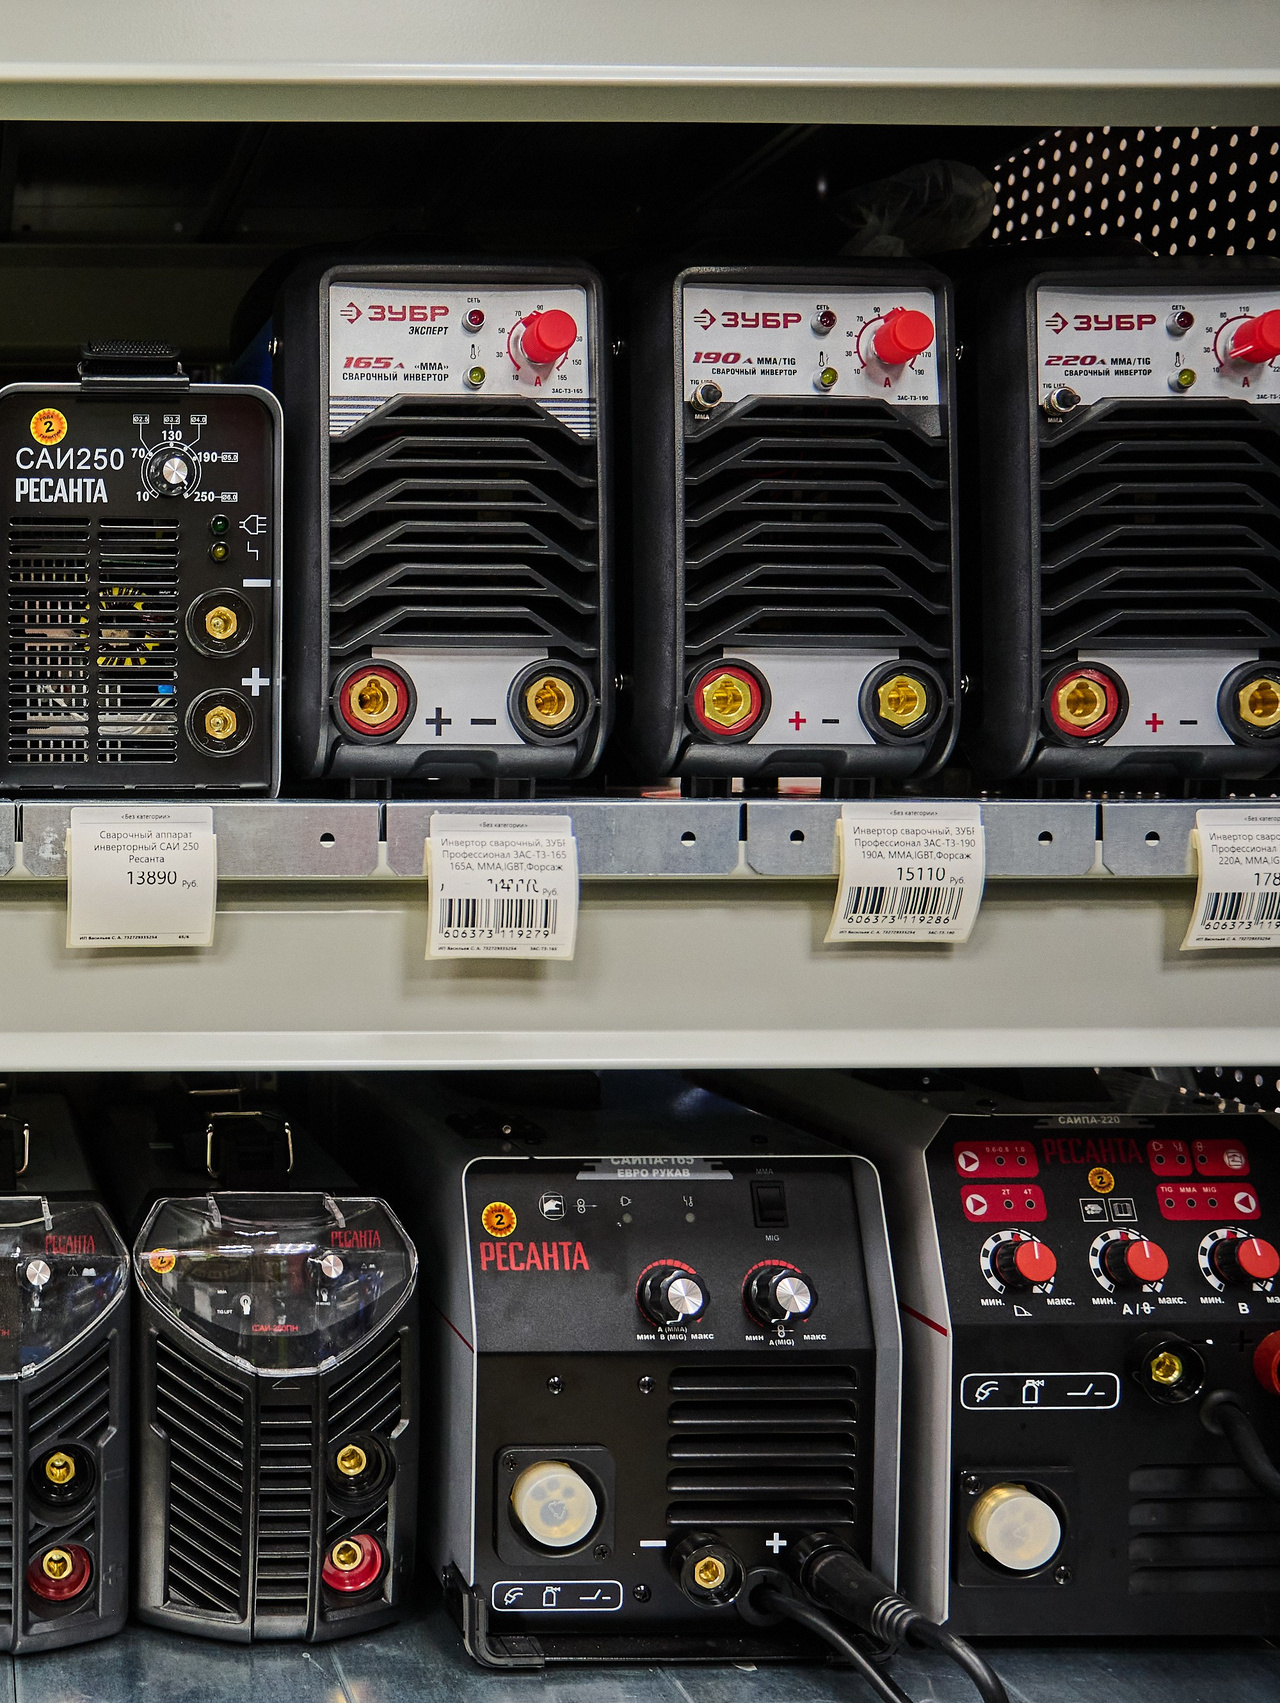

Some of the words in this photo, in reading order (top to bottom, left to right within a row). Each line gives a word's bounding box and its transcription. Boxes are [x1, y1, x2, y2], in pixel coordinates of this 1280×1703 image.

[368, 305, 449, 322] ЗУБР
[721, 312, 802, 329] ЗУБР
[1073, 314, 1156, 331] ЗУБР
[408, 326, 449, 335] ЭКСПЕРТ
[342, 370, 398, 381] СВАРОЧНЫЙ
[403, 372, 449, 382] ИНВЕРТОР
[711, 366, 756, 376] СВАРОЧНЫЙ
[760, 368, 797, 376] ИНВЕРТОР
[1064, 368, 1110, 377] СВАРОЧНЫЙ
[1114, 369, 1152, 377] ИНВЕРТОР
[43, 420, 54, 433] 2
[161, 430, 182, 441] 130
[15, 446, 125, 470] САИ250
[131, 448, 145, 459] 70
[198, 452, 218, 463] 190
[15, 477, 108, 503] РЕСАНТА
[136, 491, 149, 501] 10
[194, 491, 215, 502] 250
[99, 830, 153, 840] Сварочный
[155, 831, 192, 840] аппарат
[853, 826, 898, 836] Инвертор
[1209, 832, 1254, 842] Инвертор
[93, 842, 157, 852] инверторный
[159, 842, 180, 851] САИ
[182, 842, 199, 851] 250
[440, 838, 486, 848] Инвертор
[854, 838, 921, 848] Профессионал
[1211, 844, 1277, 854] Профессионал
[129, 854, 165, 864] Ресанта
[442, 850, 511, 860] Профессионал
[127, 870, 177, 885] 13890
[182, 880, 198, 889] Руб.
[897, 867, 946, 882] 15110
[949, 876, 965, 886] Руб.
[542, 888, 558, 897] Руб.
[847, 915, 896, 924] 606373
[902, 915, 950, 924] 119286
[1205, 921, 1252, 930] 606373
[443, 929, 493, 938] 606373
[500, 929, 550, 938] 119279
[1042, 1138, 1144, 1165] РЕСАНТА
[617, 1168, 648, 1178] ЕВРО
[652, 1168, 691, 1178] РУКАВ
[495, 1213, 505, 1226] 2
[330, 1230, 382, 1248] РЕСАНТА
[765, 1234, 780, 1242] MIG
[44, 1235, 96, 1255] РЕСАНТА
[479, 1241, 590, 1272] РЕСАНТА
[980, 1298, 1005, 1306] мин.
[1046, 1297, 1076, 1306] макс.
[1091, 1297, 1117, 1305] мин.
[1157, 1296, 1187, 1305] макс.
[1199, 1296, 1225, 1304] мин.
[803, 1333, 827, 1341] макс
